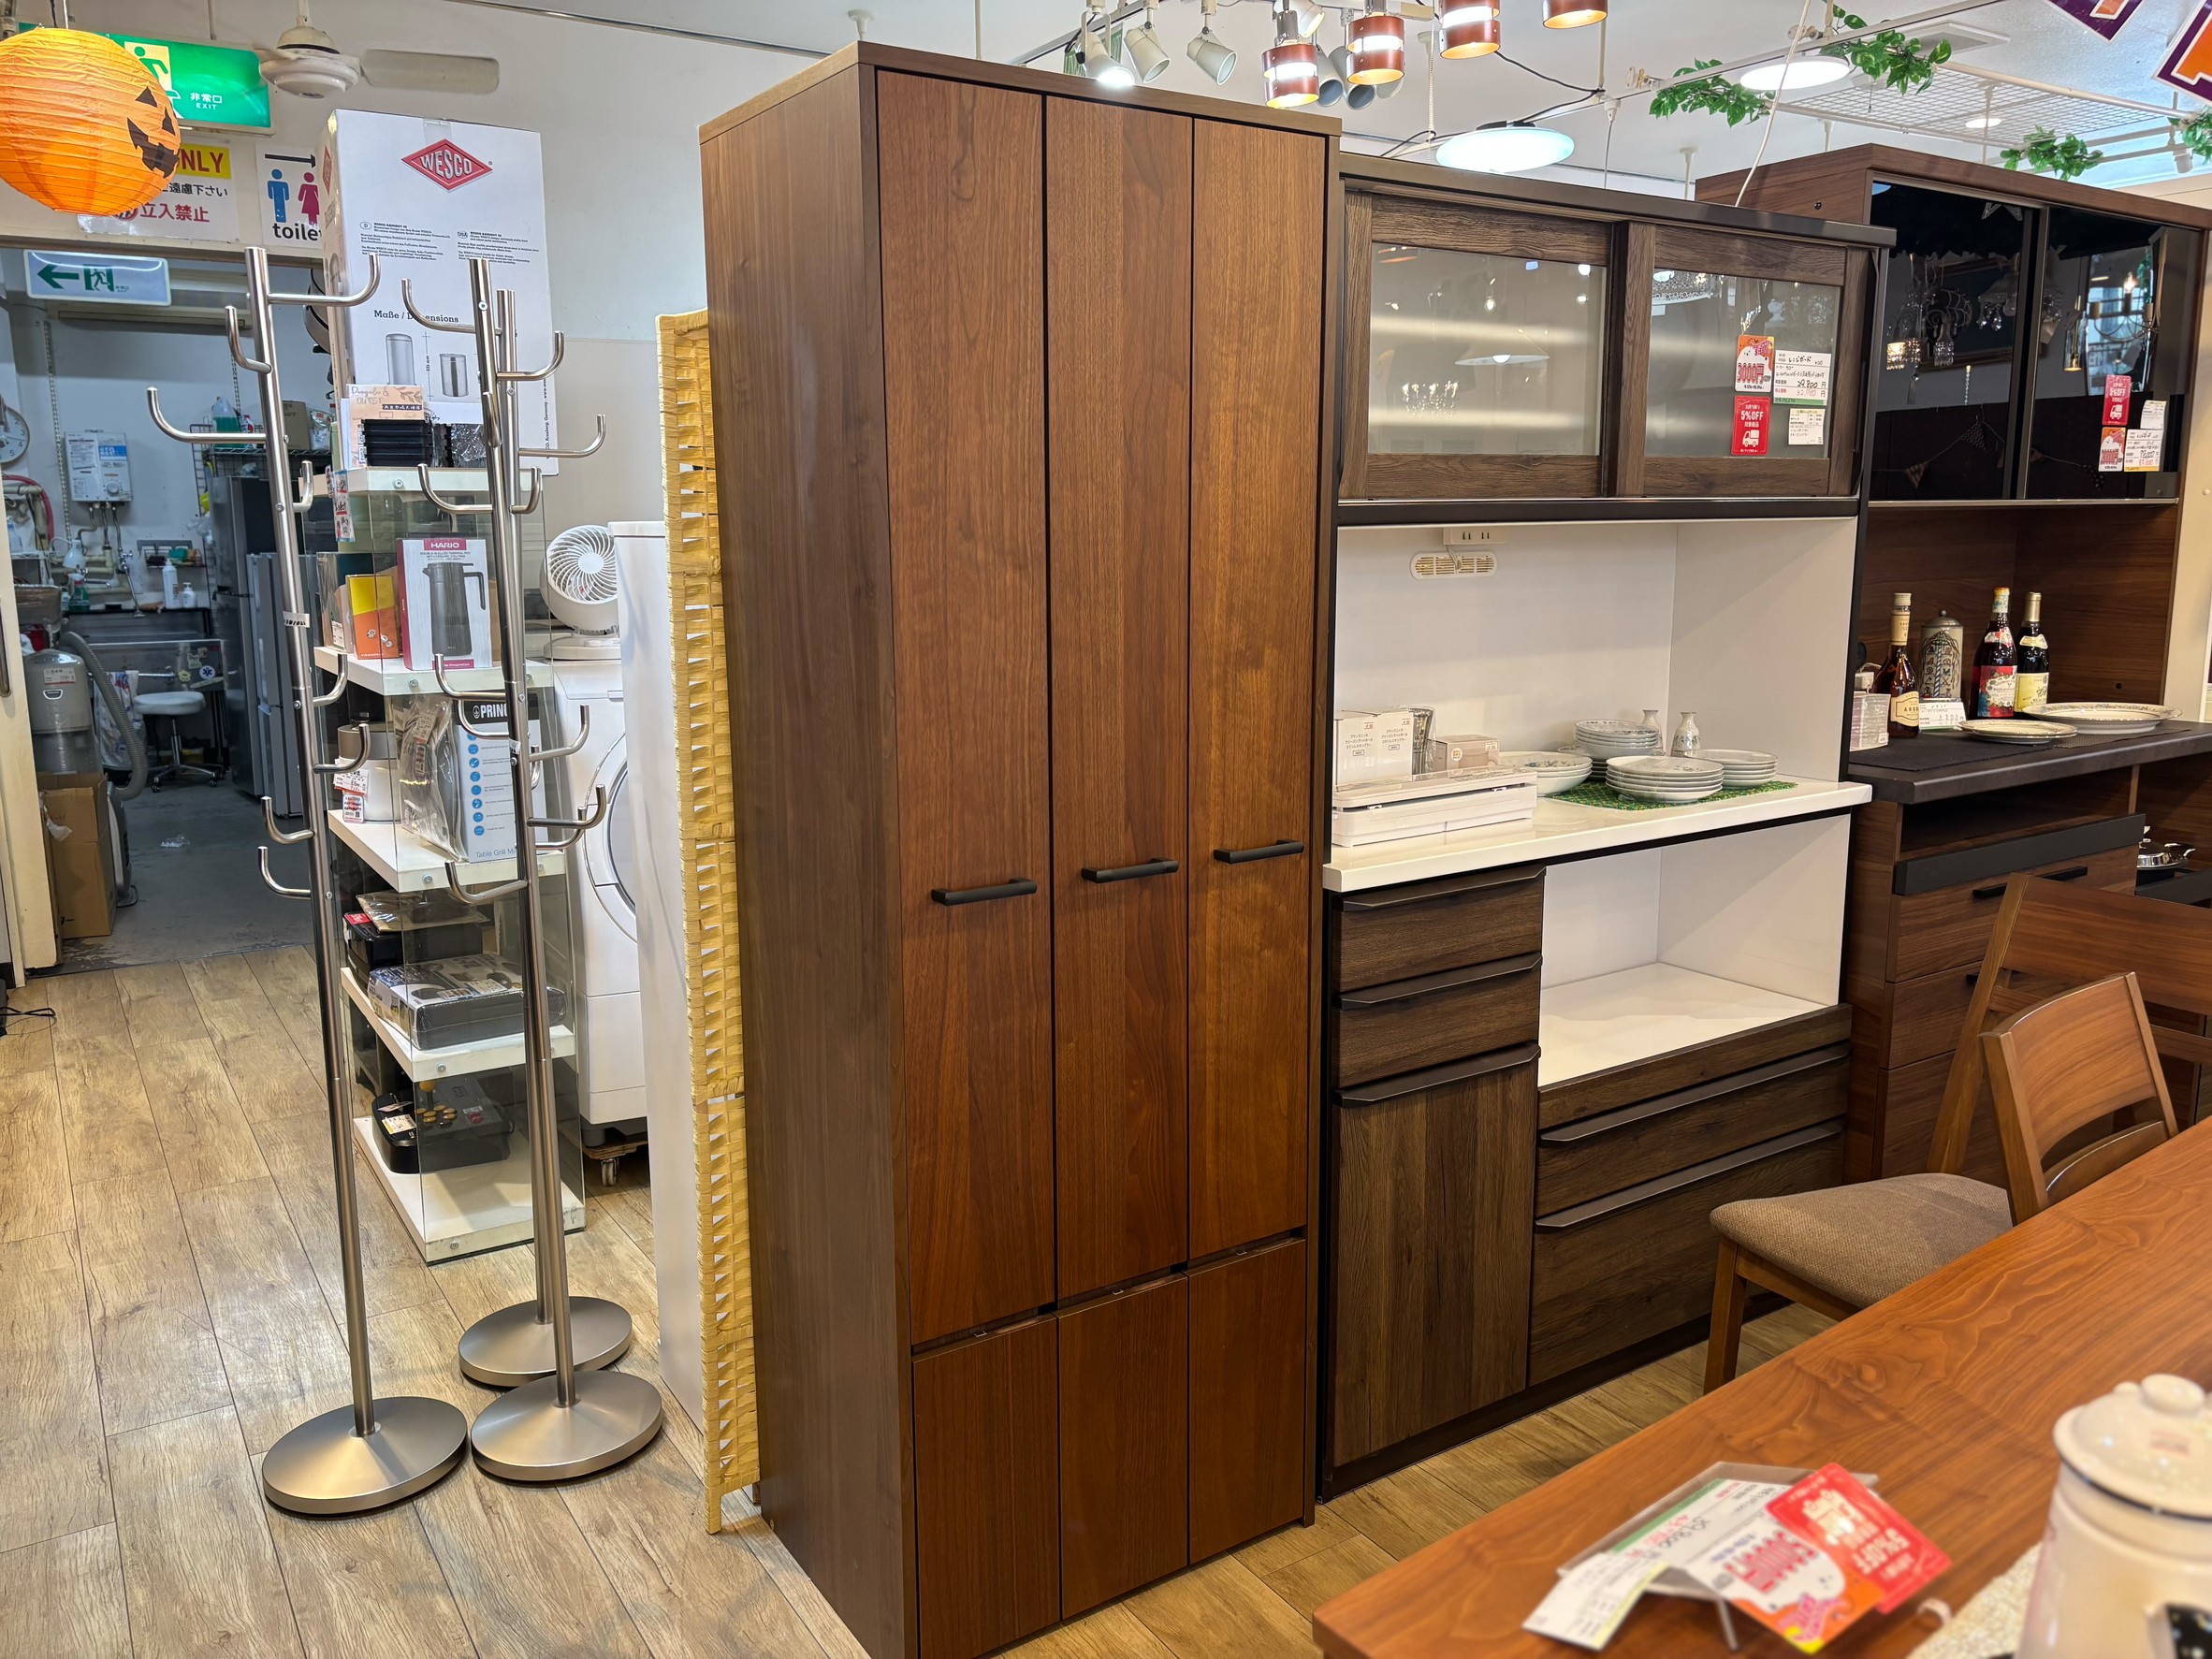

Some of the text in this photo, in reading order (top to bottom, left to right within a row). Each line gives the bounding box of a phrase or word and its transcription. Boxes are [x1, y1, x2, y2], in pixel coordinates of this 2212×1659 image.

[190, 92, 223, 104] 非常口
[196, 102, 217, 110] EXIT
[178, 148, 224, 174] NLY
[420, 149, 473, 180] WESCO
[140, 202, 211, 223] 立入禁止
[272, 222, 322, 242] toile
[373, 309, 400, 320] Maße
[407, 312, 459, 324] Densions
[357, 396, 385, 405] OUTLET
[1740, 410, 1764, 421] 5%OFF
[476, 848, 492, 858] Table
[493, 848, 506, 856] Grill
[1851, 1526, 1911, 1576] 5%OFF
